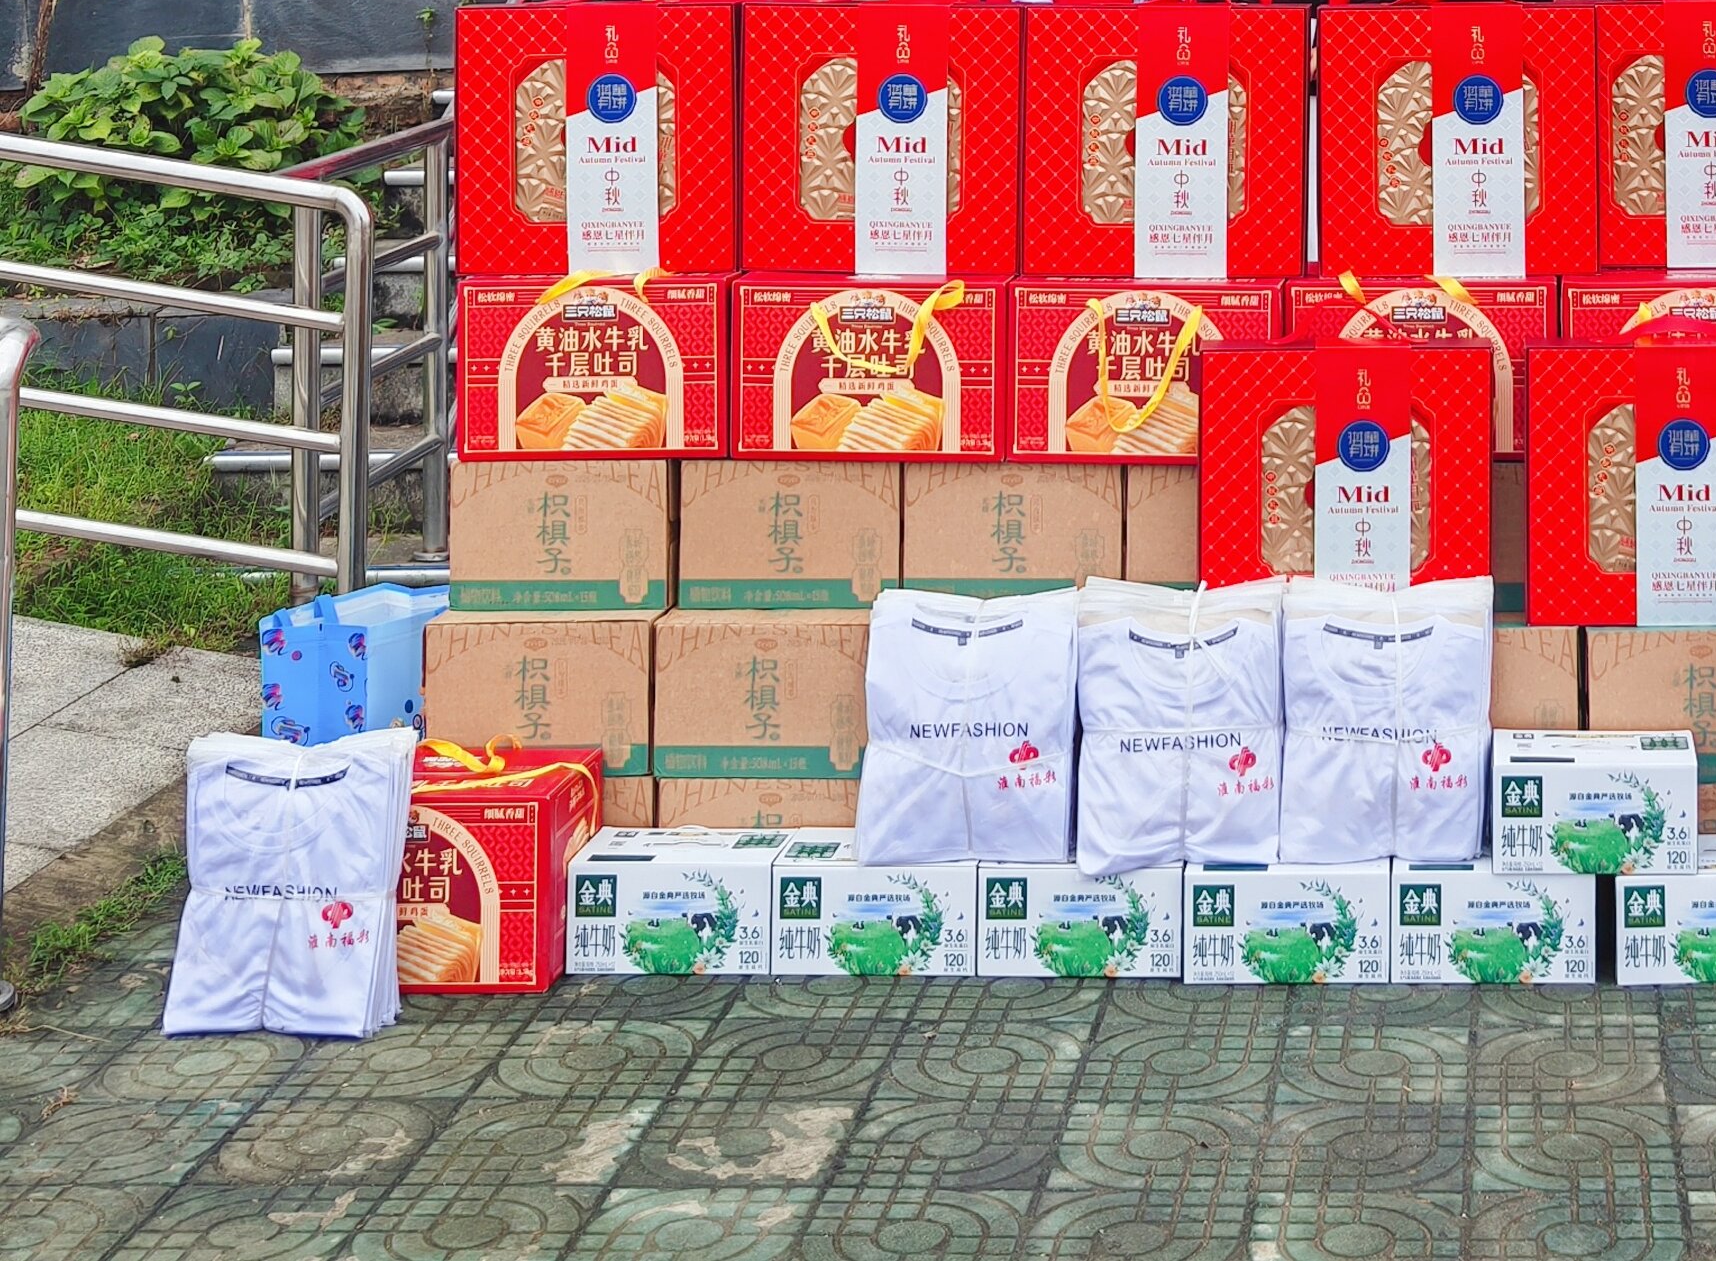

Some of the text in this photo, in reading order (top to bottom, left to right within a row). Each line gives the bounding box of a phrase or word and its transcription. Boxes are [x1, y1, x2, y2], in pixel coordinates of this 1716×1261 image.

[586, 135, 636, 153] Mid
[876, 135, 926, 153] Mid
[1156, 137, 1207, 155] Mid
[1453, 136, 1504, 154] Mid
[604, 167, 620, 205] 中秋
[893, 167, 909, 205] 中秋
[1173, 170, 1189, 209] 中秋
[1471, 169, 1487, 207] 中秋
[564, 306, 616, 318] 三只松鼠
[841, 308, 894, 320] 三只松鼠
[1116, 310, 1169, 322] 三只松鼠
[1392, 308, 1445, 320] 三只松鼠
[504, 299, 561, 372] THREE SQUIRRELS
[535, 326, 649, 352] 黄油水牛乳
[545, 352, 638, 377] 千层吐司
[1336, 484, 1389, 503] Mid
[1657, 482, 1709, 501] Mid
[1354, 517, 1371, 557] 中秋
[1676, 515, 1693, 555] 中秋
[910, 722, 1029, 739] NEWFASHION
[1120, 732, 1241, 752] NEWFASHION
[1504, 781, 1540, 807] 金典
[1501, 824, 1542, 857] 纯牛奶
[1667, 826, 1687, 840] 3.6
[432, 817, 496, 895] THREE SQUIRRELS
[1667, 851, 1687, 864] 120
[578, 880, 614, 906] 金典
[783, 882, 819, 908] 金典
[989, 883, 1025, 909] 金典
[1196, 890, 1232, 916] 金典
[1402, 889, 1438, 915] 金典
[1627, 891, 1663, 917] 金典
[574, 924, 615, 957] 纯牛奶
[779, 926, 820, 959] 纯牛奶
[985, 926, 1026, 959] 纯牛奶
[1192, 934, 1233, 967] 纯牛奶
[1359, 935, 1379, 949] 3.6
[1399, 933, 1440, 966] 纯牛奶
[1624, 935, 1665, 968] 纯牛奶
[1359, 960, 1379, 973] 120
